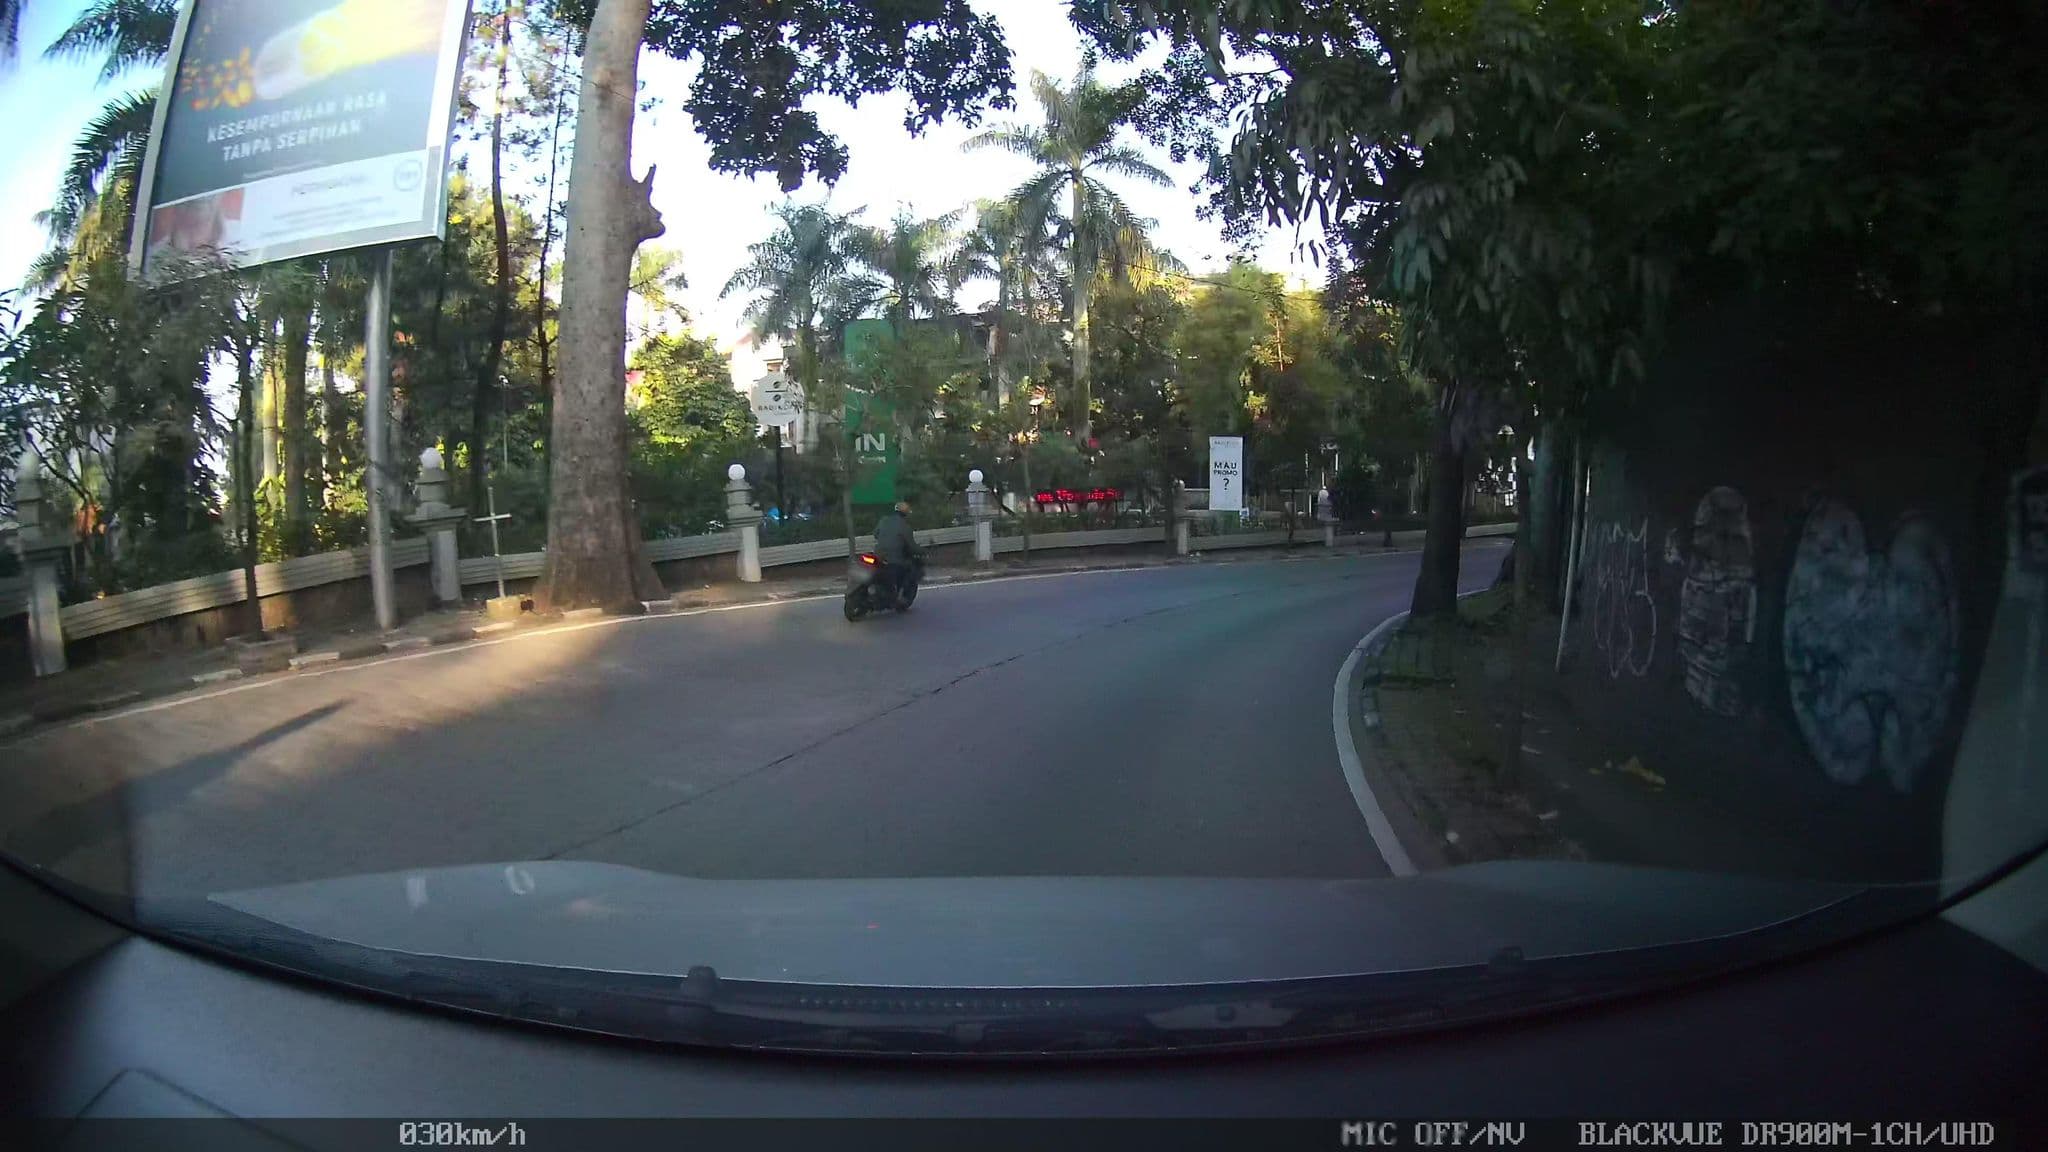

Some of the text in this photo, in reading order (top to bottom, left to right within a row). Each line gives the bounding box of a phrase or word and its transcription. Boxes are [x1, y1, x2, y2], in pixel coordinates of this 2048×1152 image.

[207, 88, 387, 143] KESEMPURNAAN RASA
[222, 118, 361, 162] TANPA SERPIHAN
[1214, 462, 1237, 470] MAU
[1223, 477, 1230, 491] ?
